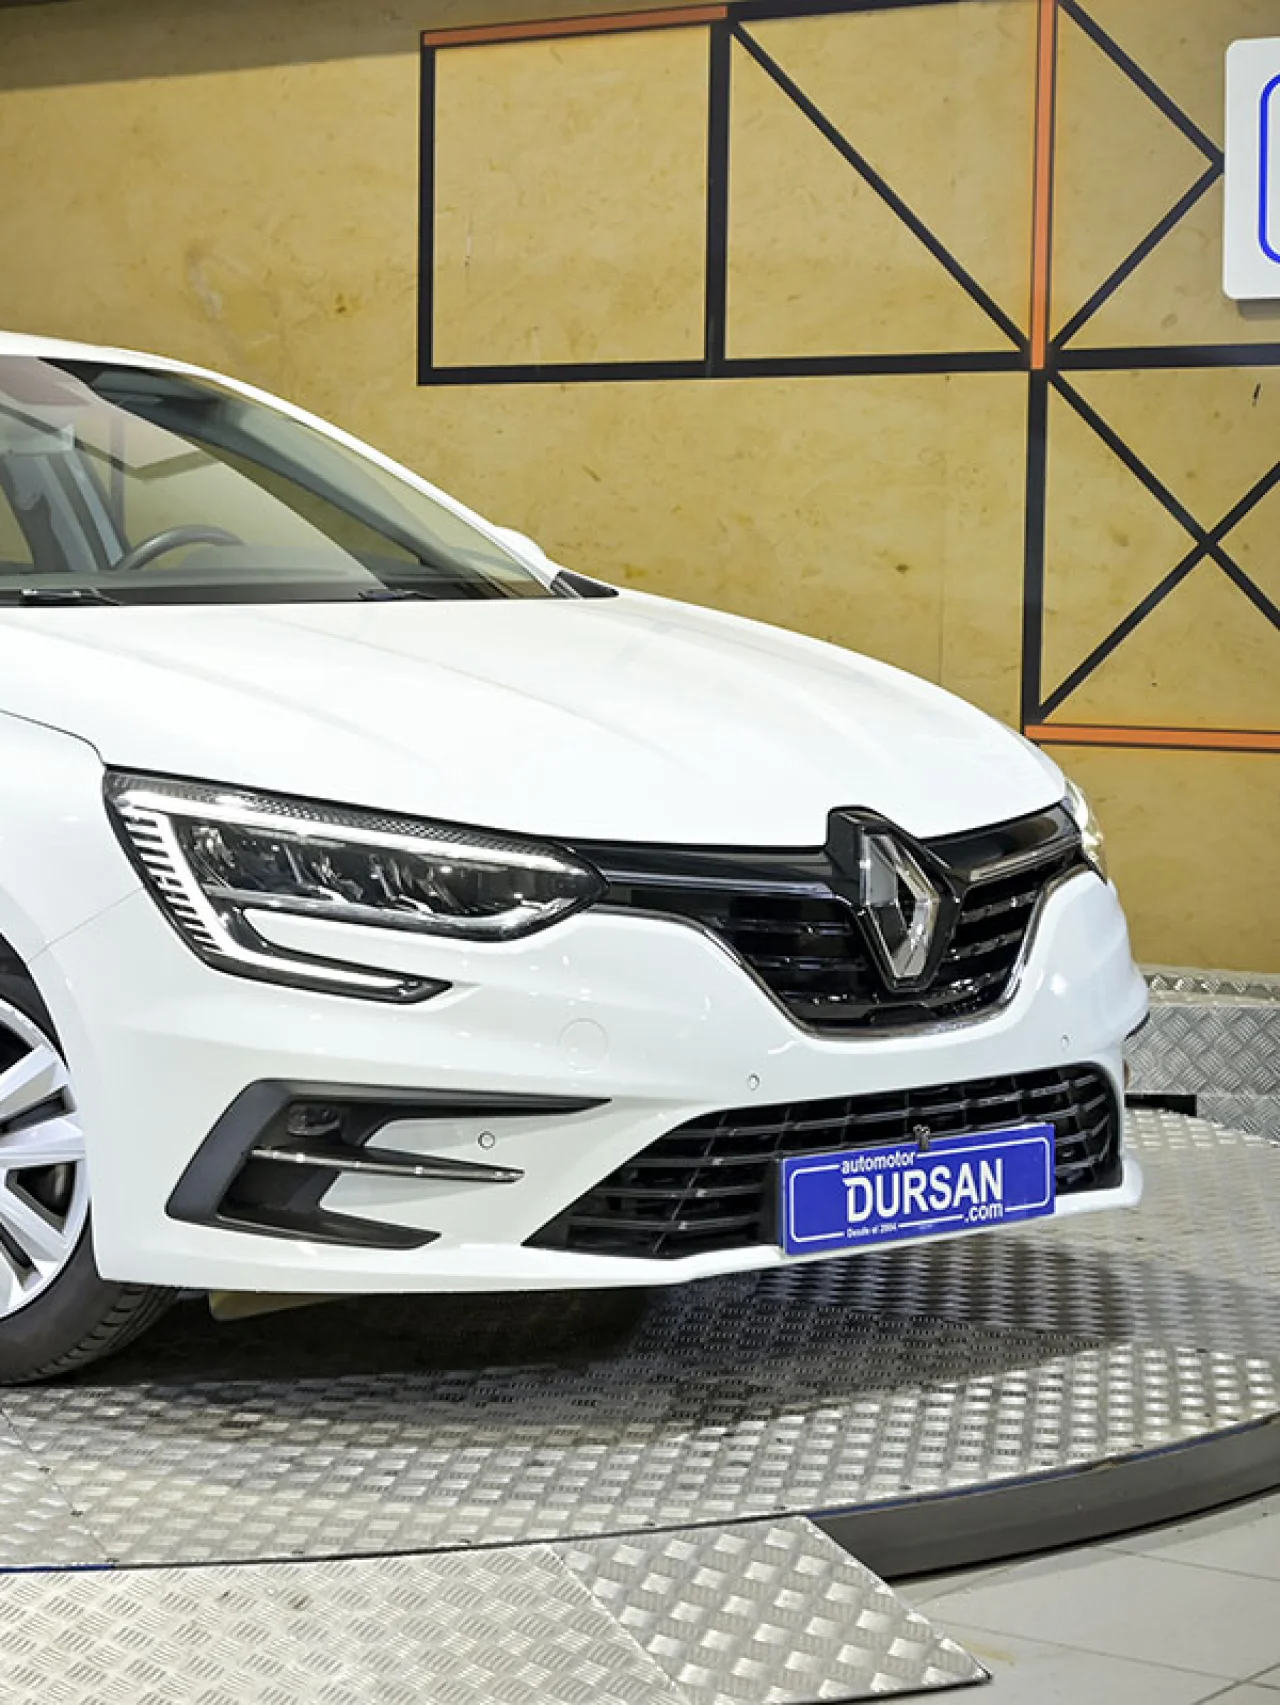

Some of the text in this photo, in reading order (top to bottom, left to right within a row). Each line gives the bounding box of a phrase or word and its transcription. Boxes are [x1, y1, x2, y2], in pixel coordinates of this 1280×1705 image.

[841, 1150, 917, 1174] automotor
[842, 1158, 1004, 1224] DURSAN
[964, 1202, 1004, 1224] .com
